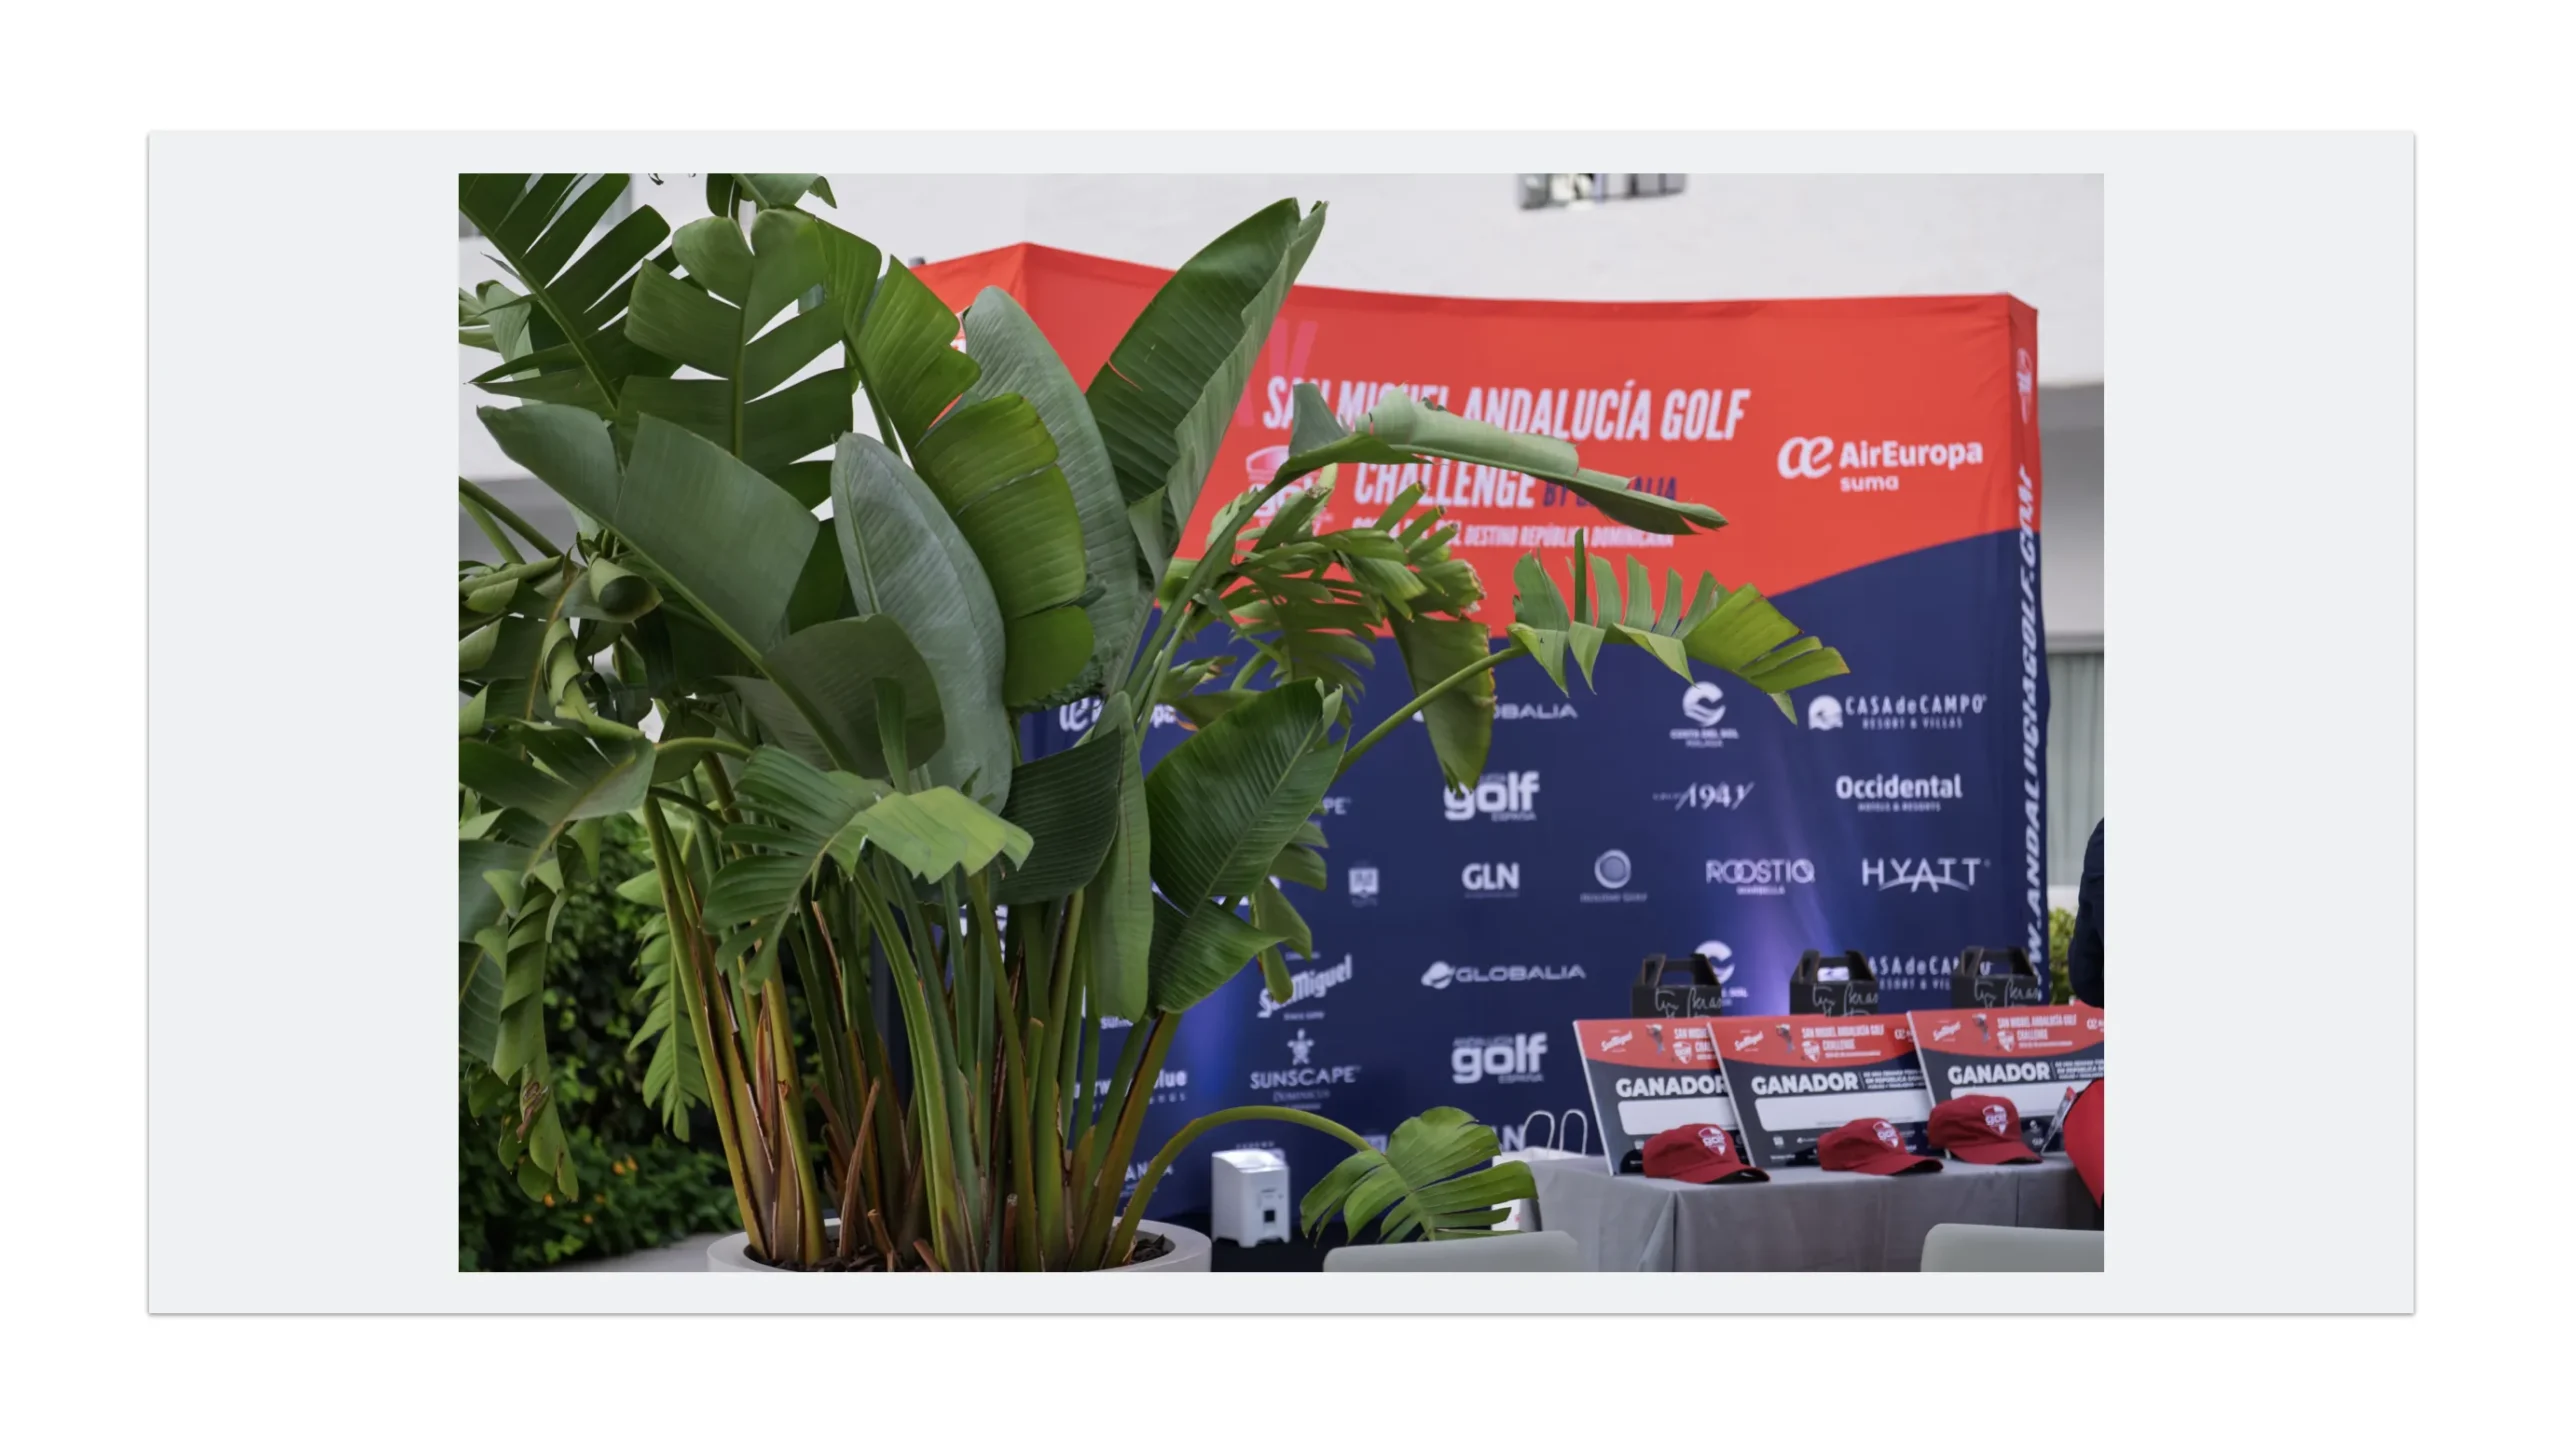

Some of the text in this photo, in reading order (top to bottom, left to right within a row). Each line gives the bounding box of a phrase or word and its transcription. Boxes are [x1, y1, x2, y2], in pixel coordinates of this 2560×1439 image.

[1462, 378, 1652, 441] ANDALUCÍA
[1660, 388, 1751, 441] GOLF
[1839, 440, 1984, 471] AirEuropa
[1354, 455, 1537, 508] CHALLENGE
[1840, 475, 1899, 492] suma
[1493, 702, 1578, 719] BALIA
[1862, 717, 1906, 730] RESORT
[1922, 716, 1963, 730] VILLAS
[1443, 771, 1540, 821] golf
[1835, 773, 1963, 799] Occidental
[1461, 862, 1520, 890] GLN
[1861, 857, 1982, 893] HYATT
[1455, 964, 1587, 982] GLOBALIA
[1879, 978, 1915, 990] ESORT
[1451, 1032, 1548, 1084] golf
[1250, 1066, 1356, 1089] SUNSCAPE
[1751, 1071, 1859, 1096] GANADOR
[1948, 1061, 2051, 1086] GANADOR
